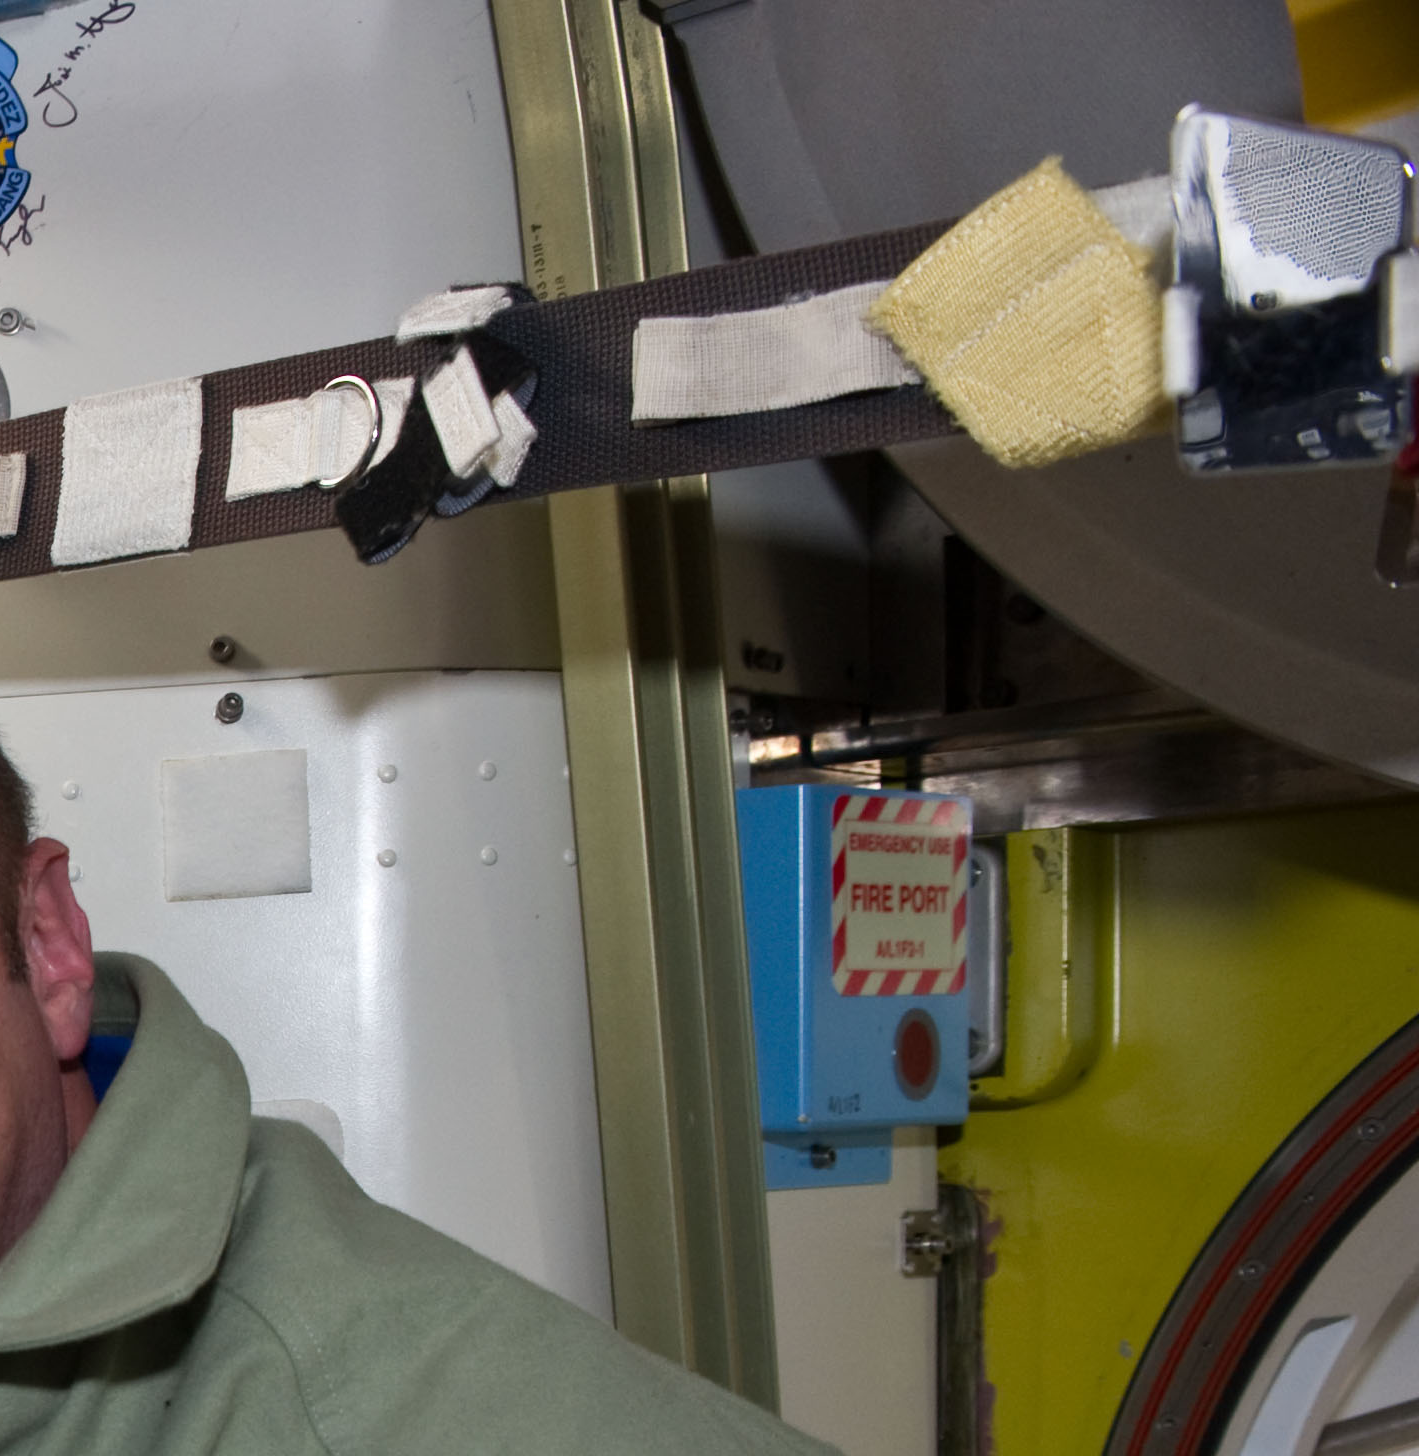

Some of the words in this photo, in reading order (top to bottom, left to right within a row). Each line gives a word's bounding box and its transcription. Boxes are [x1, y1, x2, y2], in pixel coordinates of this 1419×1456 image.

[849, 832, 923, 854] EMERGENCY
[928, 836, 952, 854] USE
[851, 883, 893, 913] FIRE
[899, 885, 950, 913] PORT
